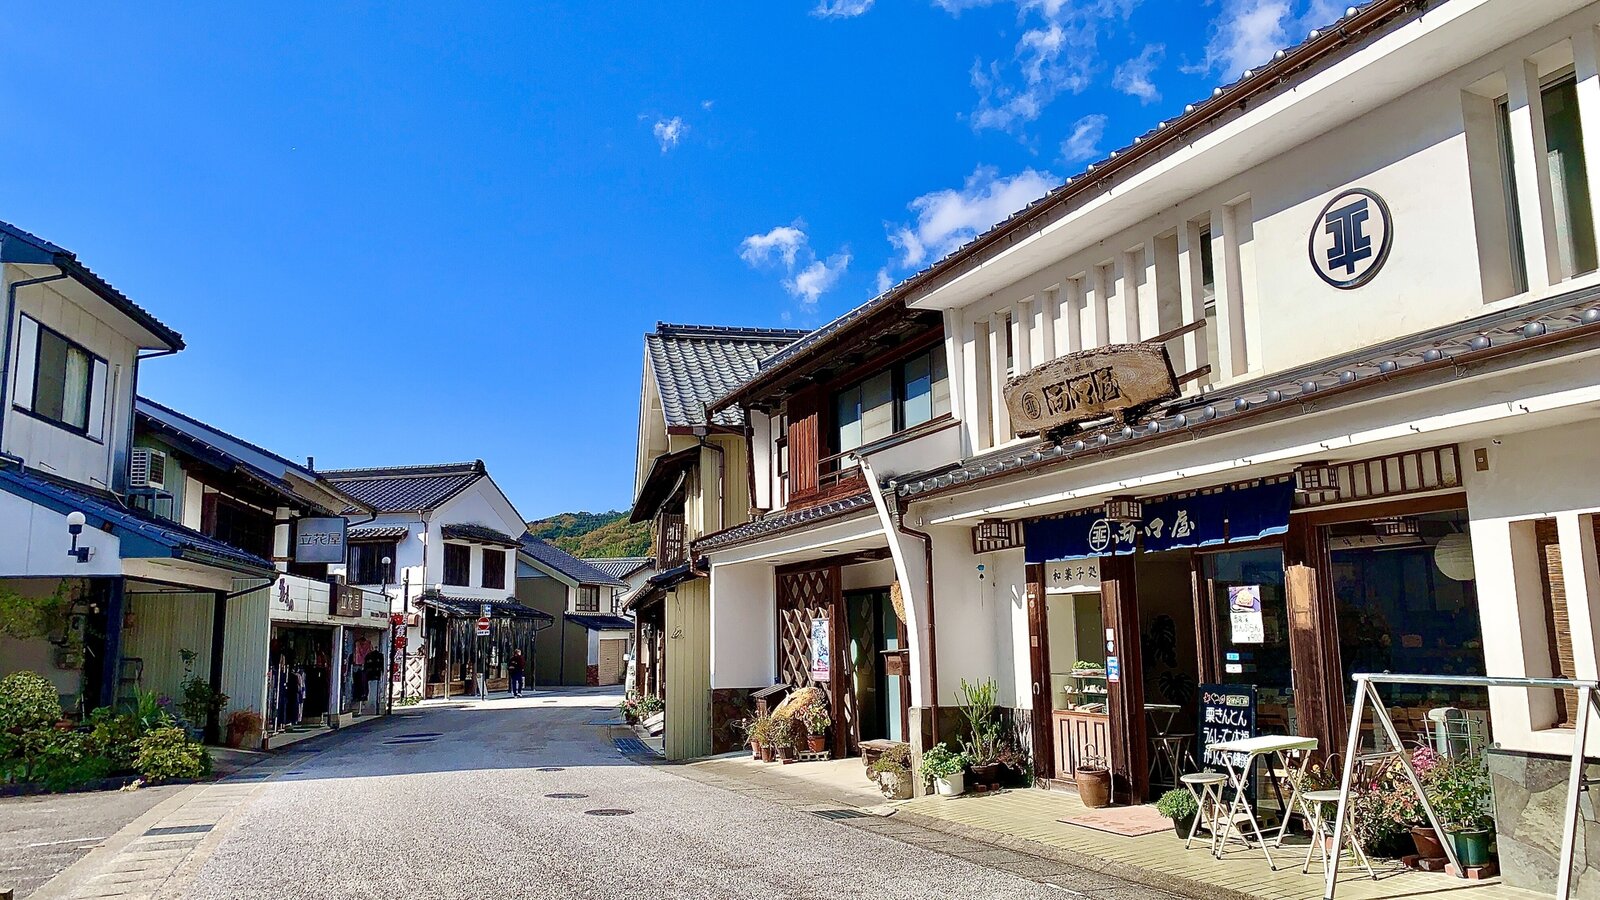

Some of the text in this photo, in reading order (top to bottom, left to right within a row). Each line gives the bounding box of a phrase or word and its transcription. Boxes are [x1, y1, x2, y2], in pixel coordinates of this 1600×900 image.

[300, 531, 341, 546] 立花屋
[1052, 565, 1097, 582] 和菓子処
[1205, 707, 1248, 727] 栗きんとん
